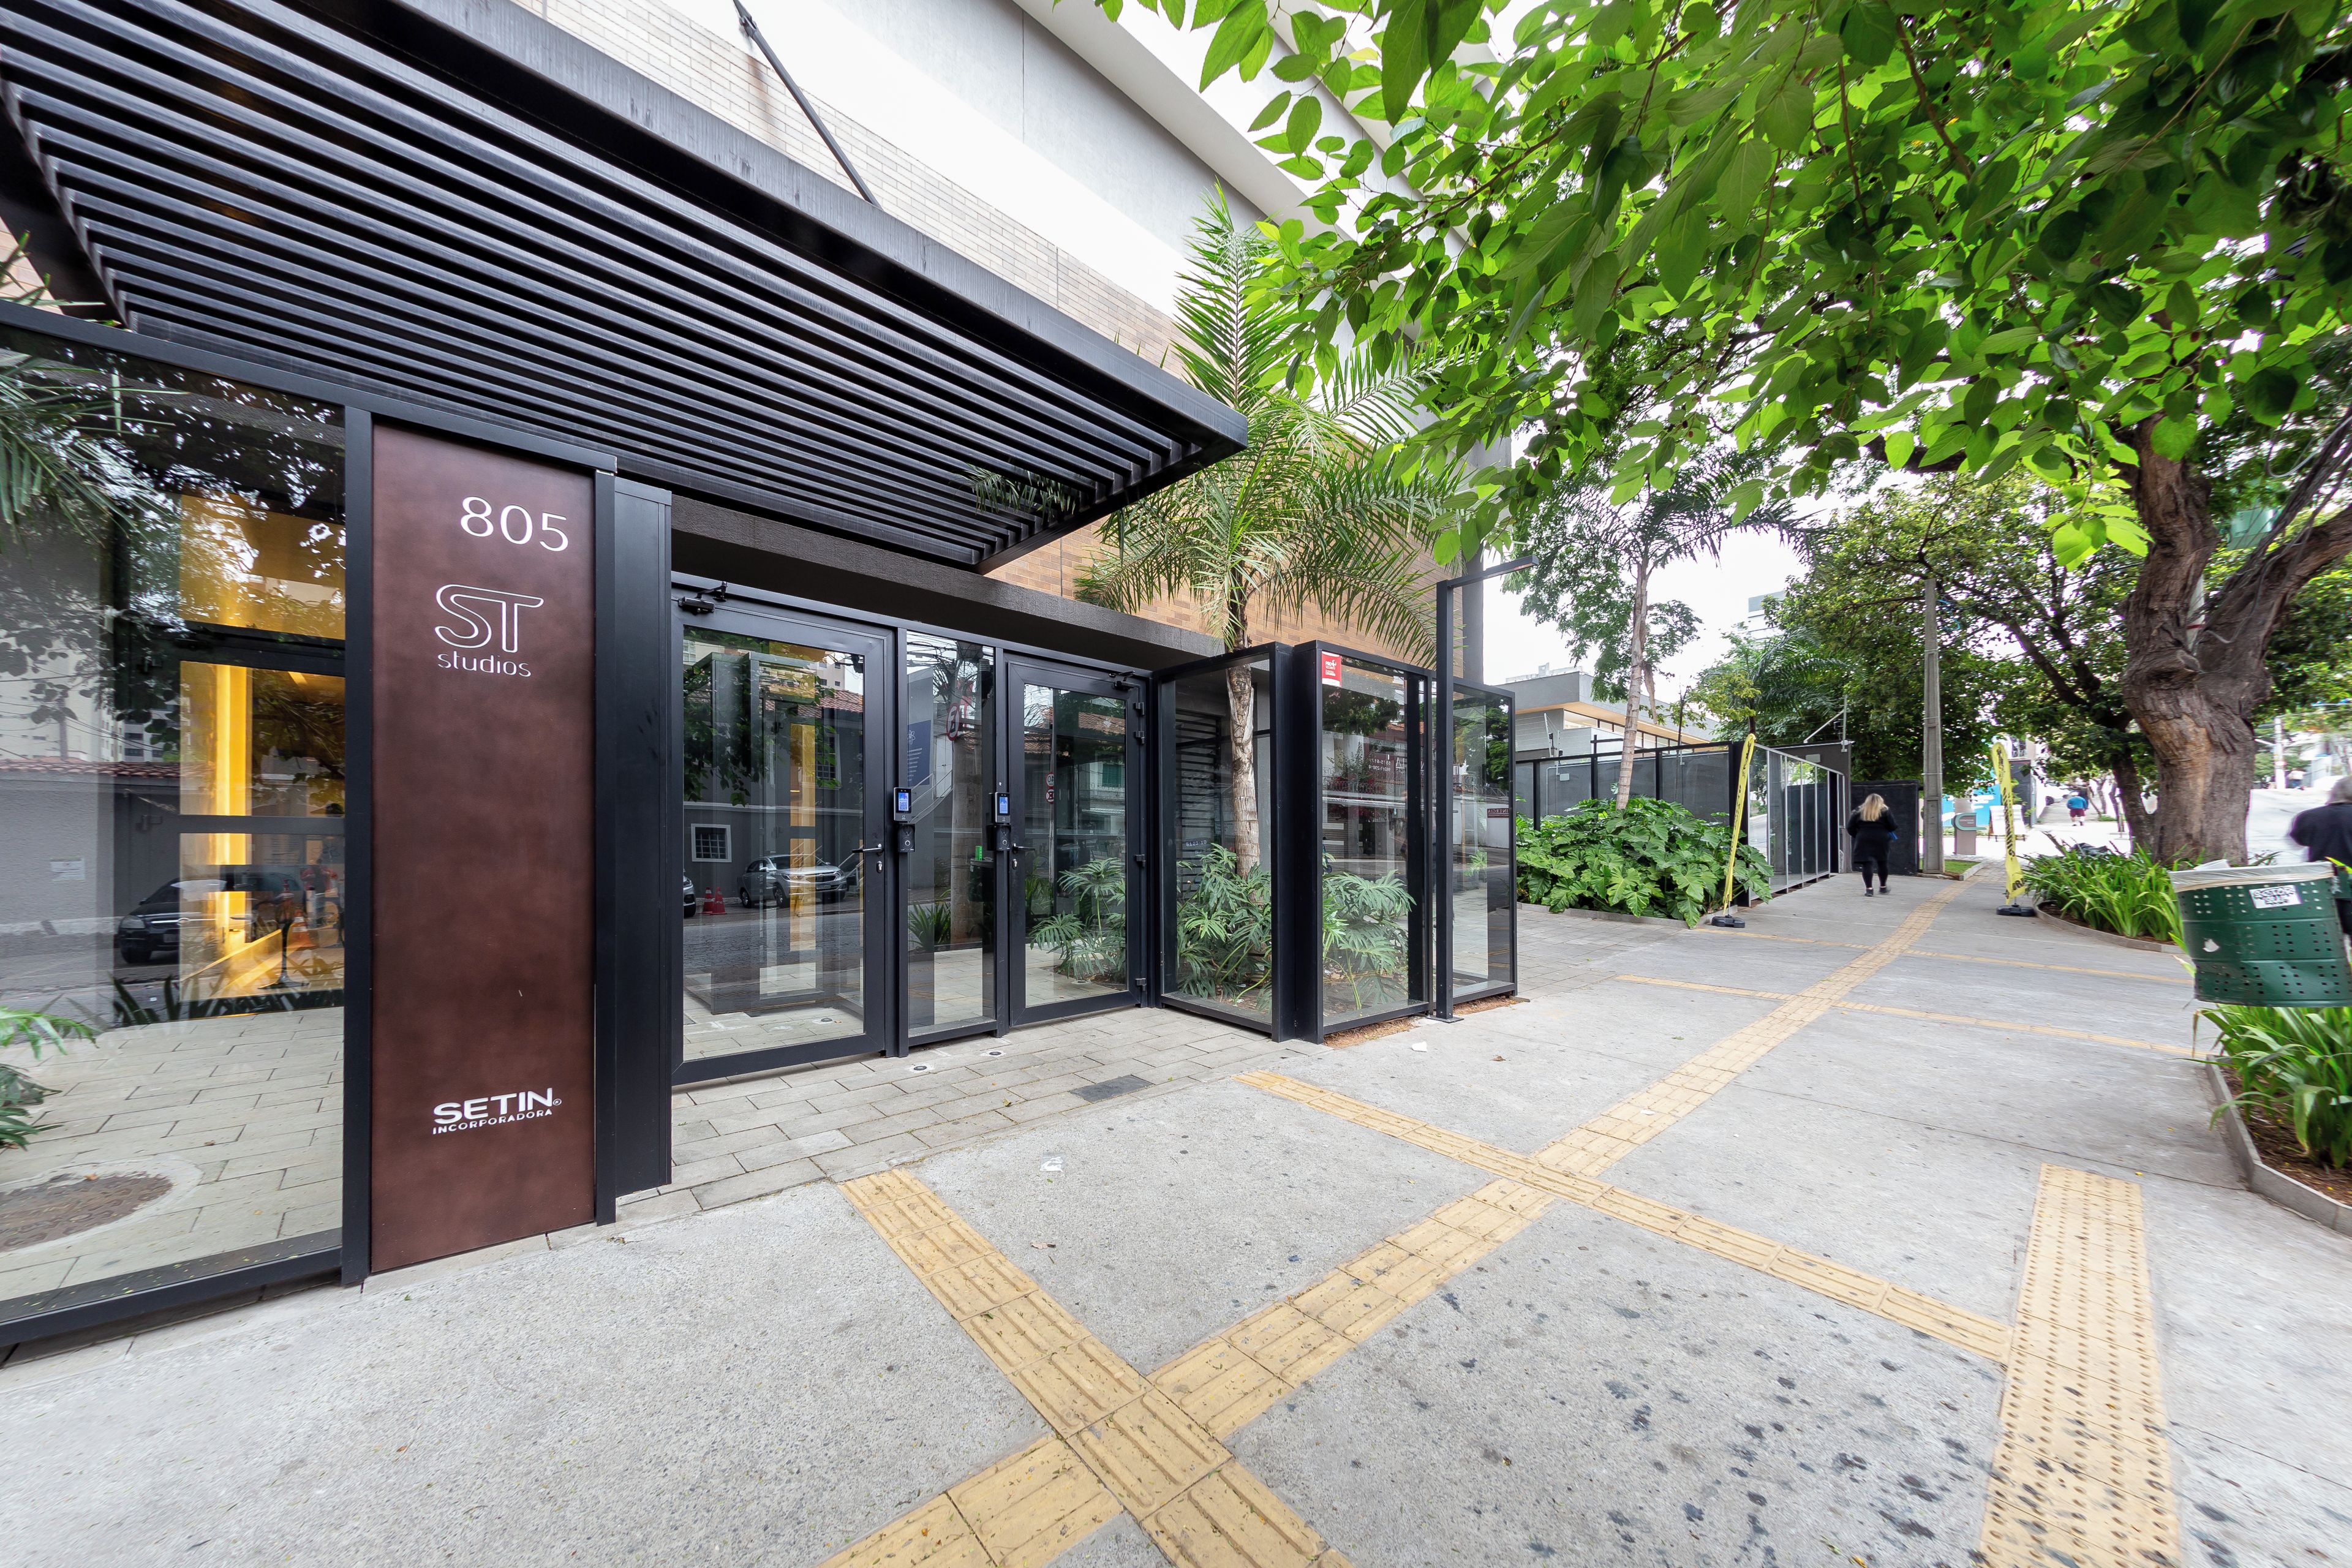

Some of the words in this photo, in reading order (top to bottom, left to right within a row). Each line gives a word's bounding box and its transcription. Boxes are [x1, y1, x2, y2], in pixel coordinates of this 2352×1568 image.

[461, 496, 569, 552] 805
[434, 584, 544, 654] ST
[437, 650, 532, 677] studios
[432, 1109, 552, 1134] INCORPORADORA
